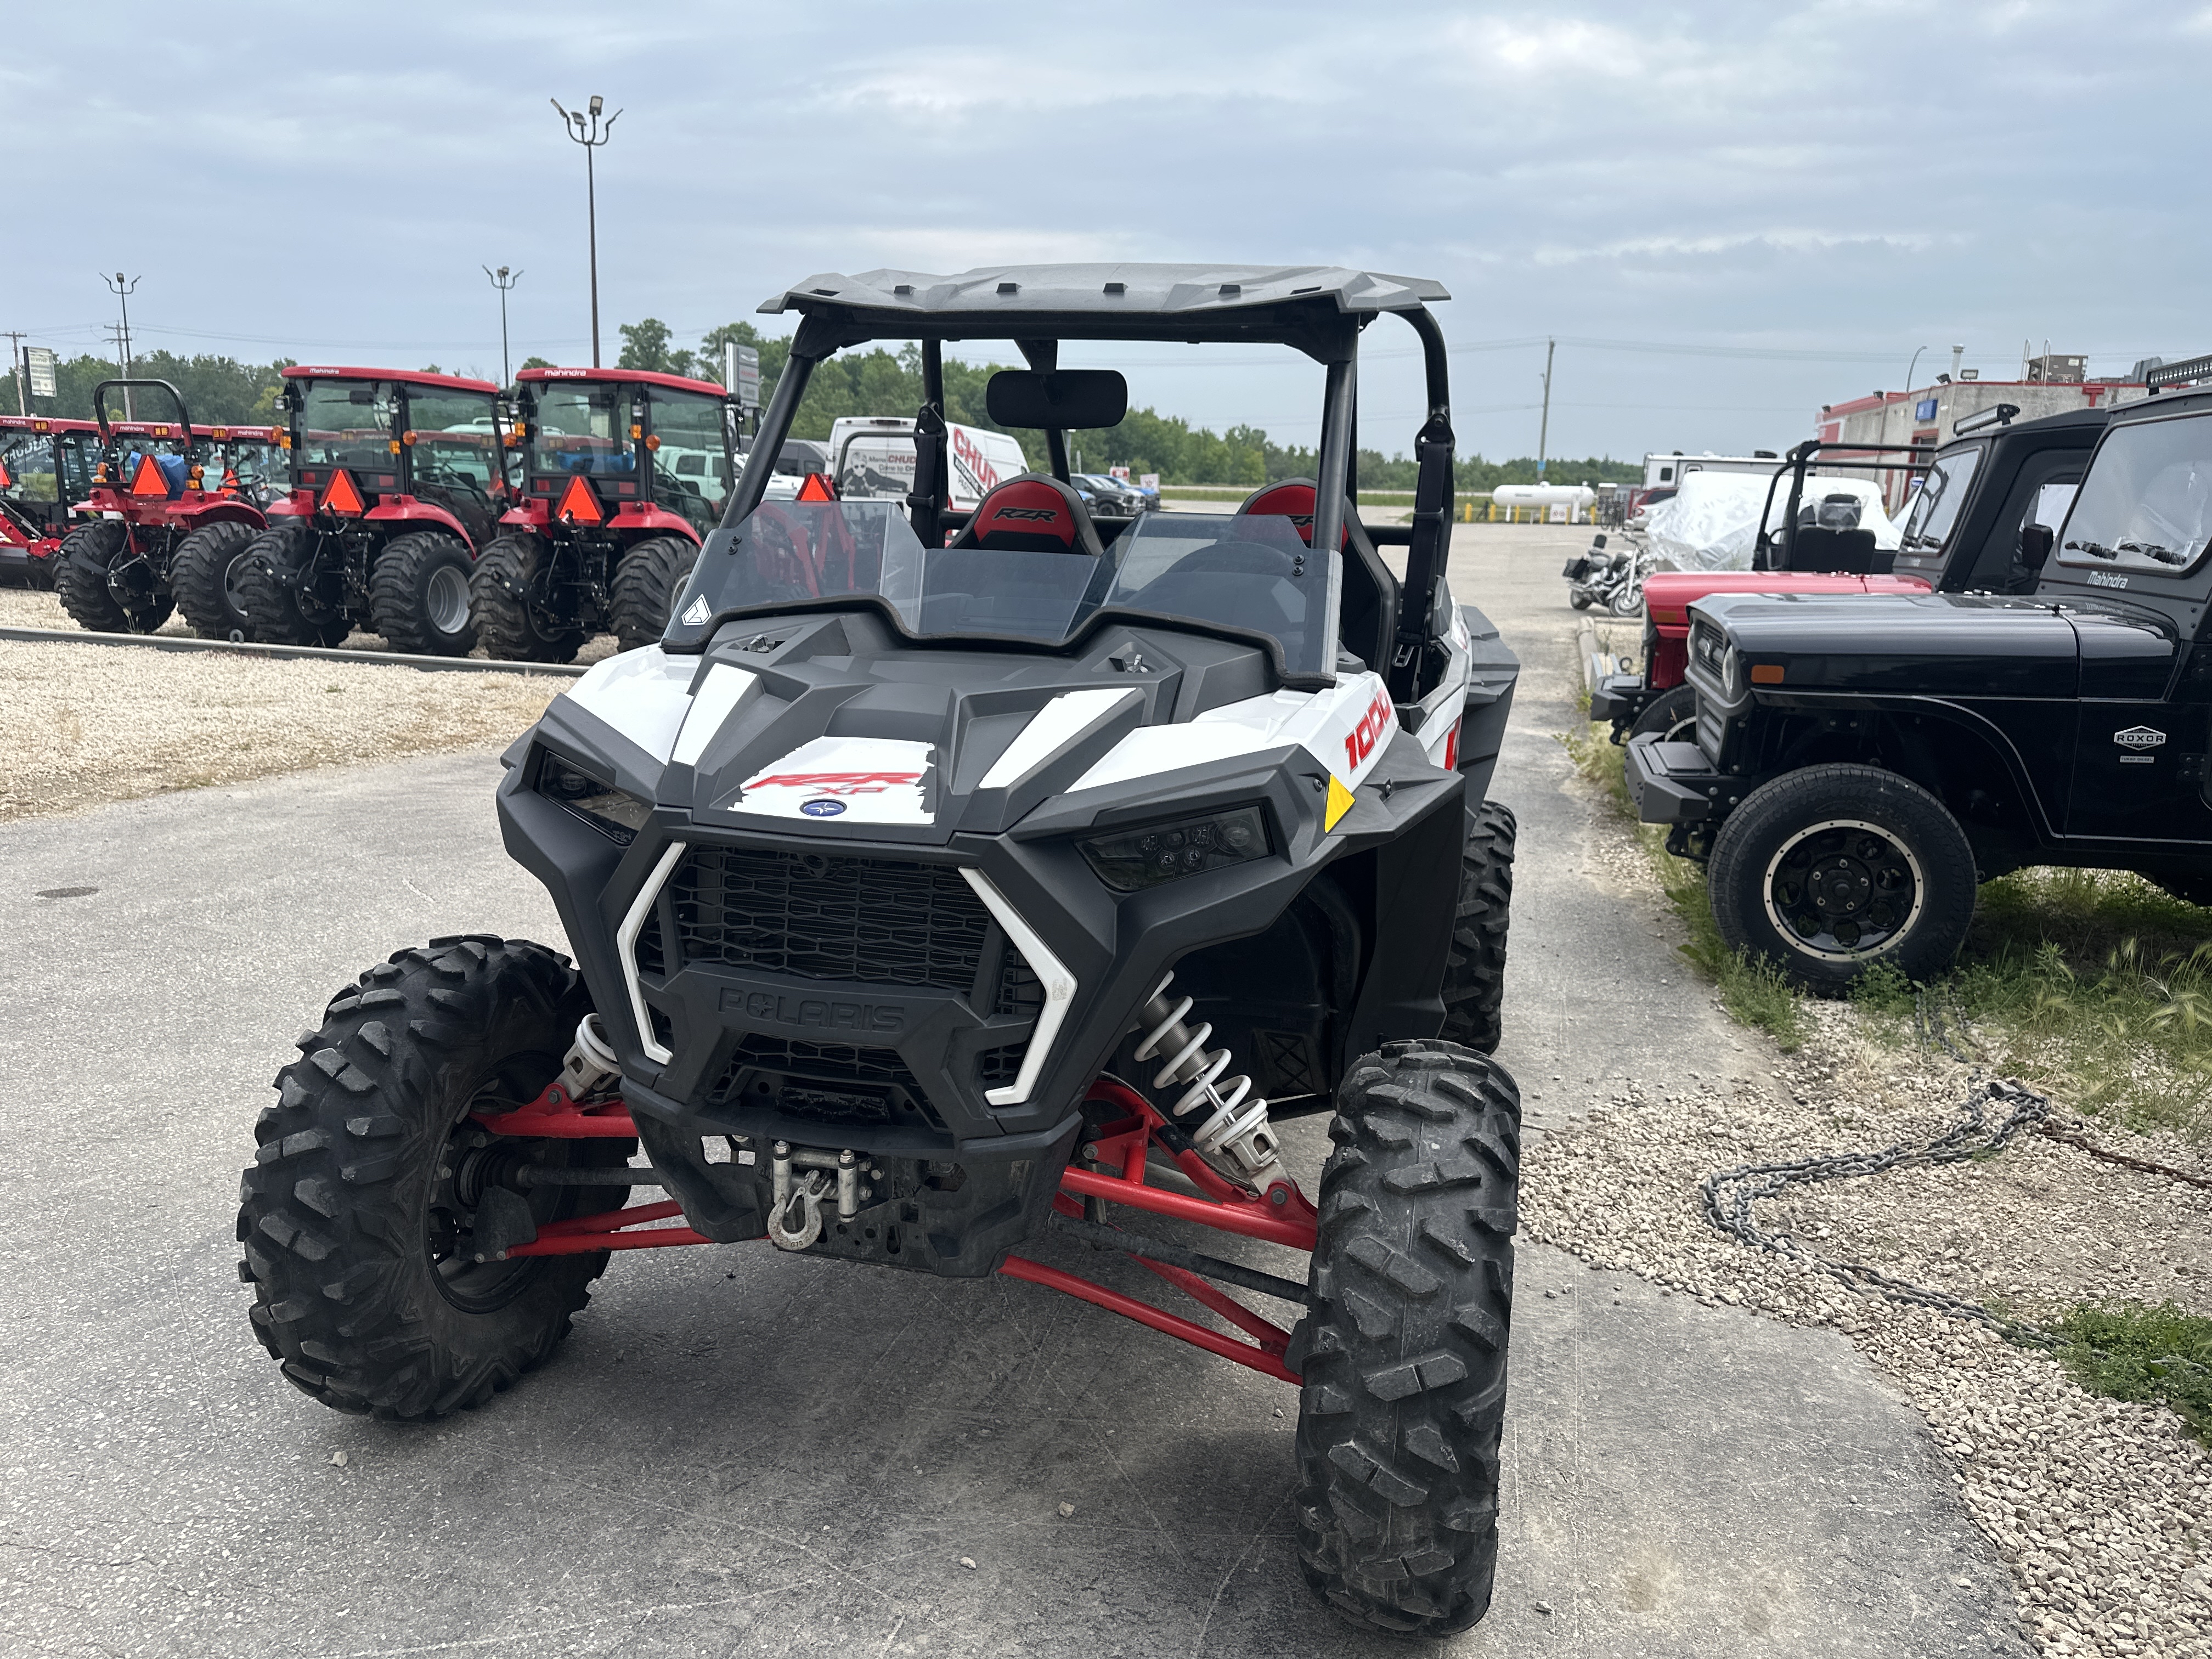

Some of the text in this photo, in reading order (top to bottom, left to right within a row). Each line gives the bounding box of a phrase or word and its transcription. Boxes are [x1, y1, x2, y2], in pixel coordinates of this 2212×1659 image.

[888, 455, 917, 464] CHUD
[953, 426, 1002, 491] CHUD
[992, 506, 1058, 523] RZR
[1344, 686, 1392, 775] 1000
[741, 772, 923, 791] RZR
[800, 786, 890, 797] XP
[718, 987, 905, 1034] POLARIS
